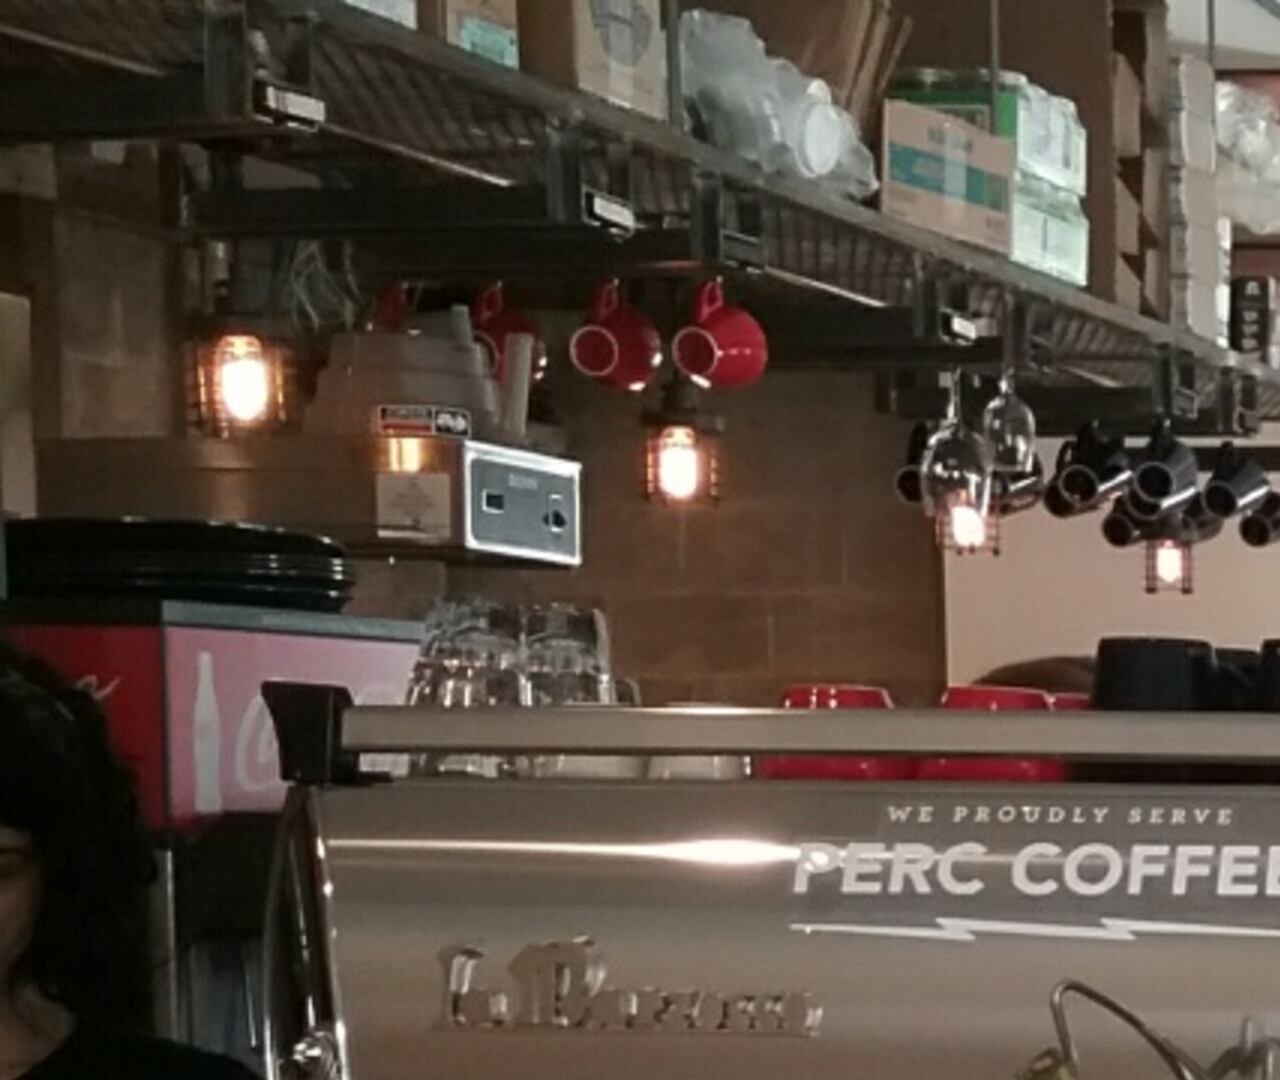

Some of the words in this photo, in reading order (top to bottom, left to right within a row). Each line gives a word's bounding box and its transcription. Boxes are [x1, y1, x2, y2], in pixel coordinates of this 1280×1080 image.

[887, 805, 934, 824] WE
[952, 805, 1110, 825] PROUDLY
[1127, 807, 1234, 826] SERVE
[792, 841, 989, 896] PERC
